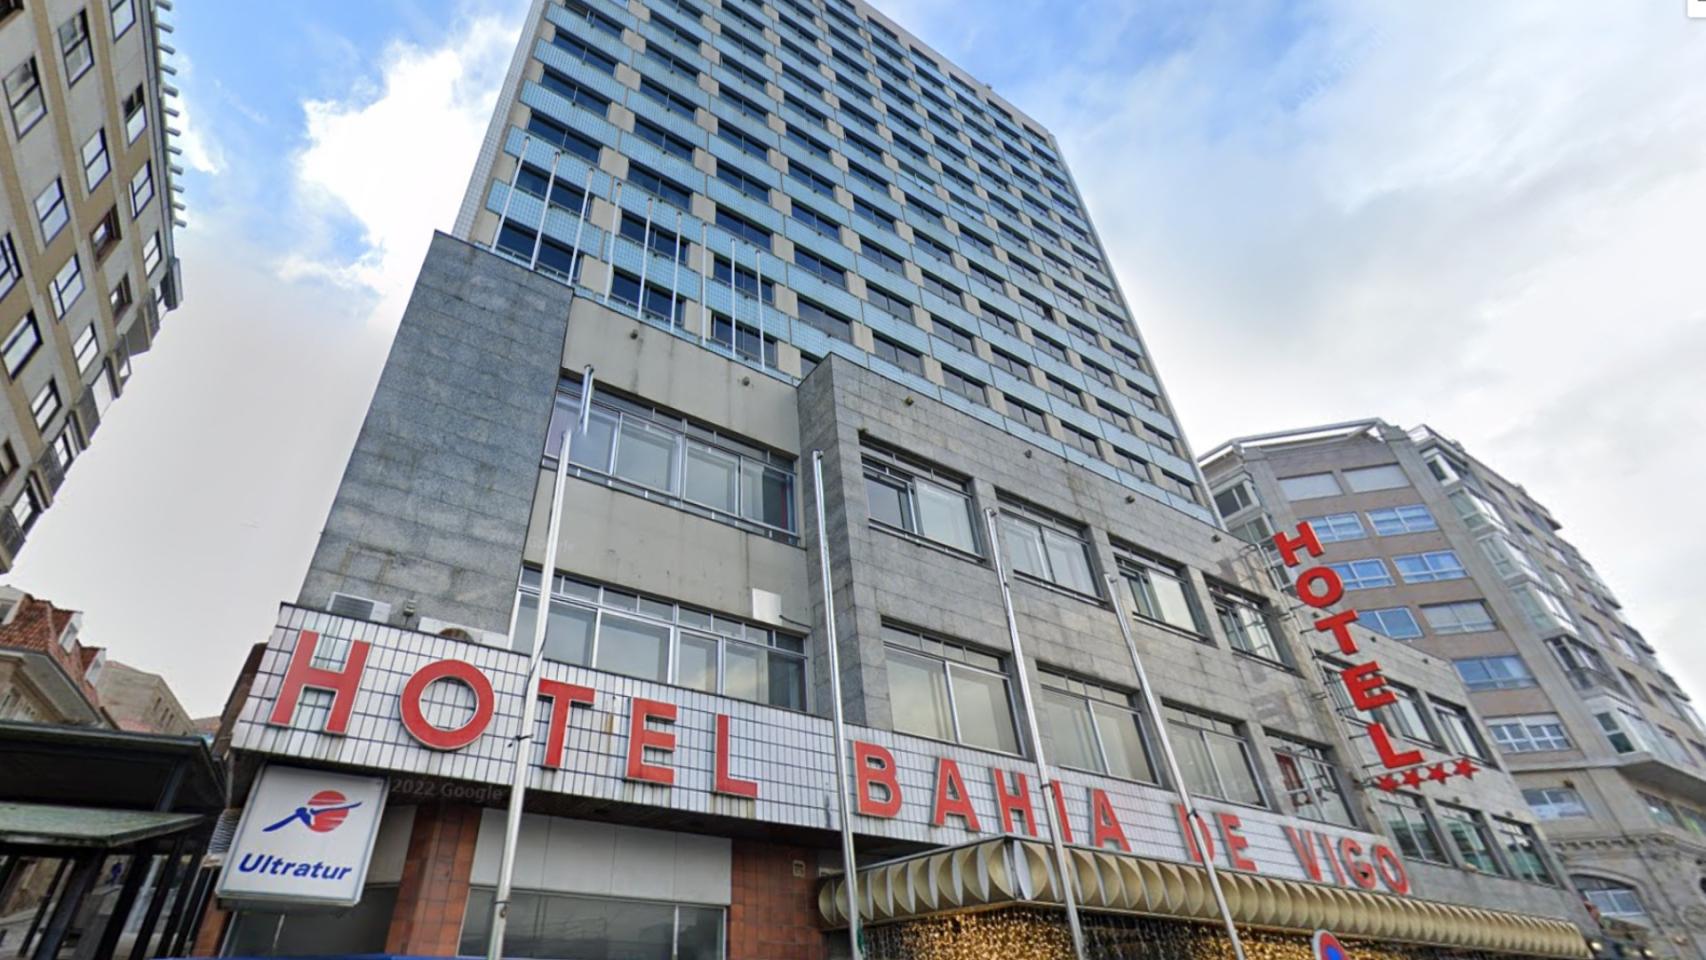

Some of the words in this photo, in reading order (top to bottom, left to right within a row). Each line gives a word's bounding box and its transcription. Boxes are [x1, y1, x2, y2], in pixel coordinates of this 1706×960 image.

[269, 630, 758, 798] HOTEL
[853, 740, 1132, 852] BAHIA
[1175, 802, 1257, 872] DE
[1283, 825, 1408, 895] VIGO
[1272, 520, 1425, 769] HOTEL
[238, 852, 353, 881] Ultratur
